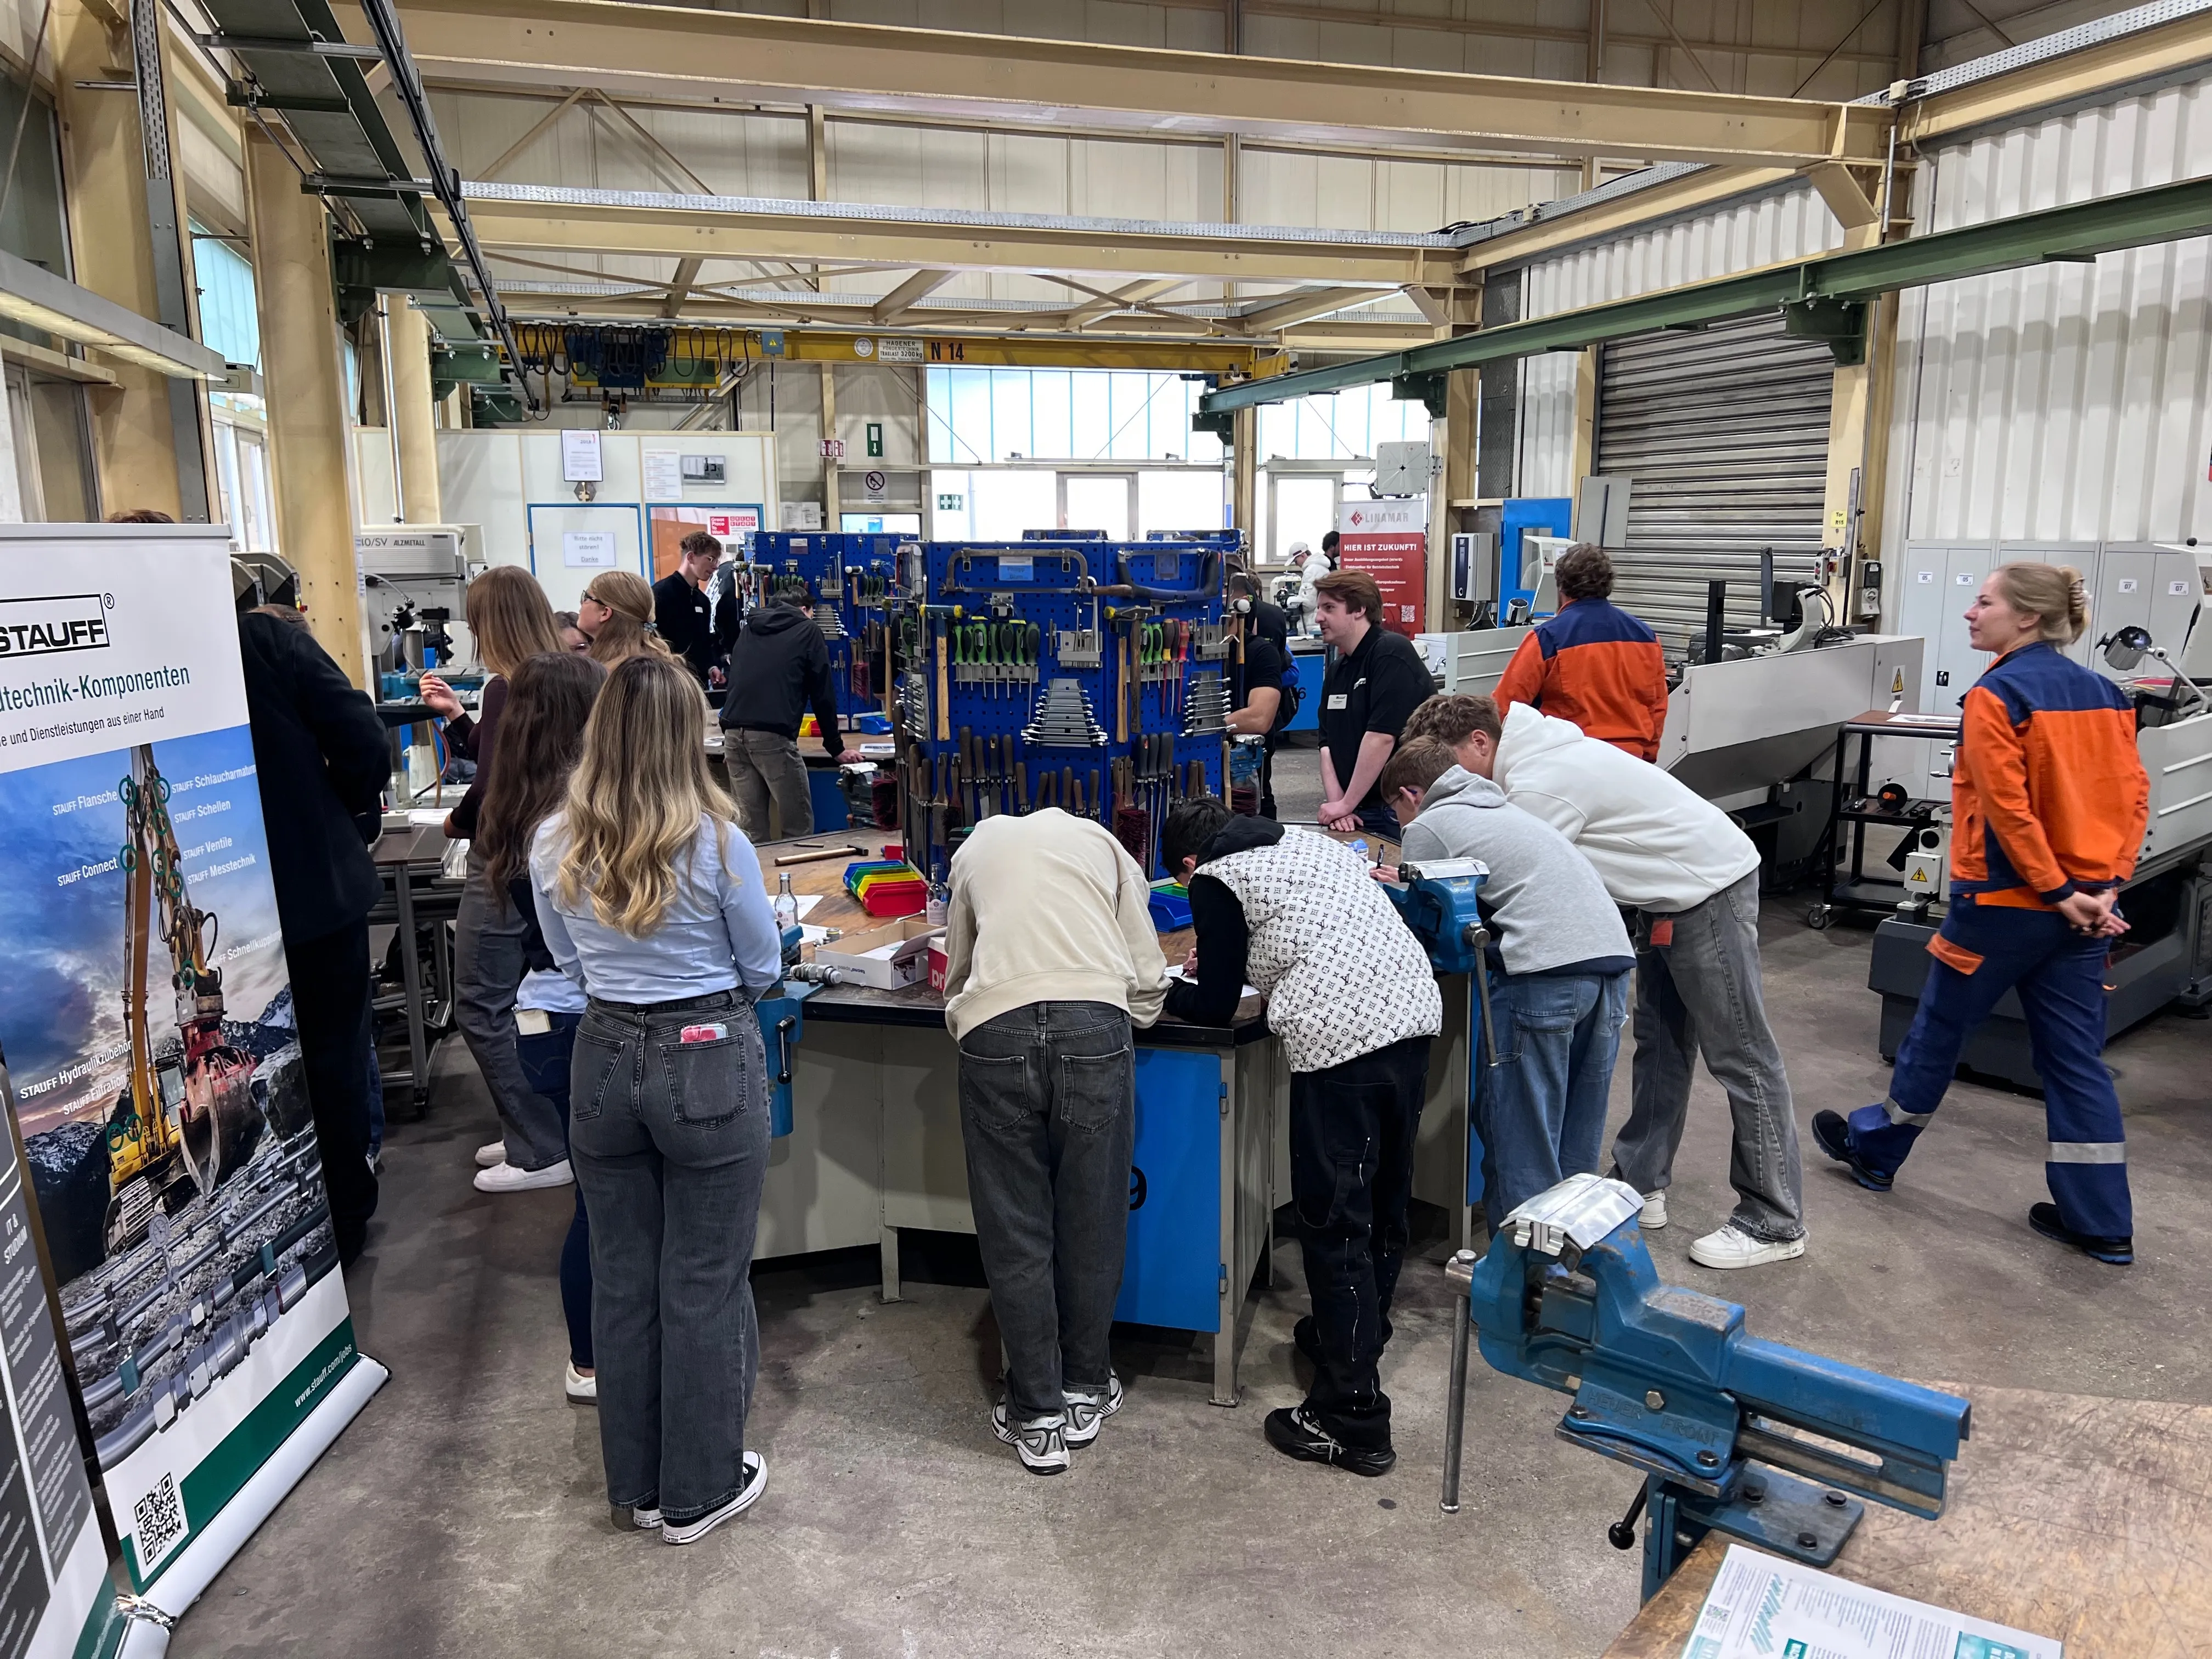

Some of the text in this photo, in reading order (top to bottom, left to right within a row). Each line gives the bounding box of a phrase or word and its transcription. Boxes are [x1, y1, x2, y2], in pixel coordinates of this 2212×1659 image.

[931, 342, 964, 360] N 14
[1365, 512, 1409, 523] LINAMAR
[1378, 543, 1417, 551] ZUKUNFT!
[0, 619, 105, 652] STAUFF
[10, 729, 28, 745] und
[30, 718, 105, 741] Dienstleistungen
[107, 715, 121, 728] aus
[123, 711, 142, 725] einer
[144, 706, 165, 721] Hand
[171, 779, 194, 794] STAUFF
[52, 789, 118, 816] STAUFF Flansche
[174, 799, 231, 824] STAUFF Schellen
[183, 836, 233, 861] STAUFF Ventile
[57, 856, 118, 887] STAUFF Connect
[187, 853, 257, 885] STAUFF Messtechnik
[206, 953, 227, 969] STAUFF
[20, 1040, 132, 1099] STAUFF Hydraulikzubehör
[63, 1074, 127, 1115] STAUFF Filtration
[295, 1344, 352, 1408] www.stauff.com/jobs
[1587, 1390, 1644, 1420] HEUER
[1661, 1415, 1722, 1447] FRONT
